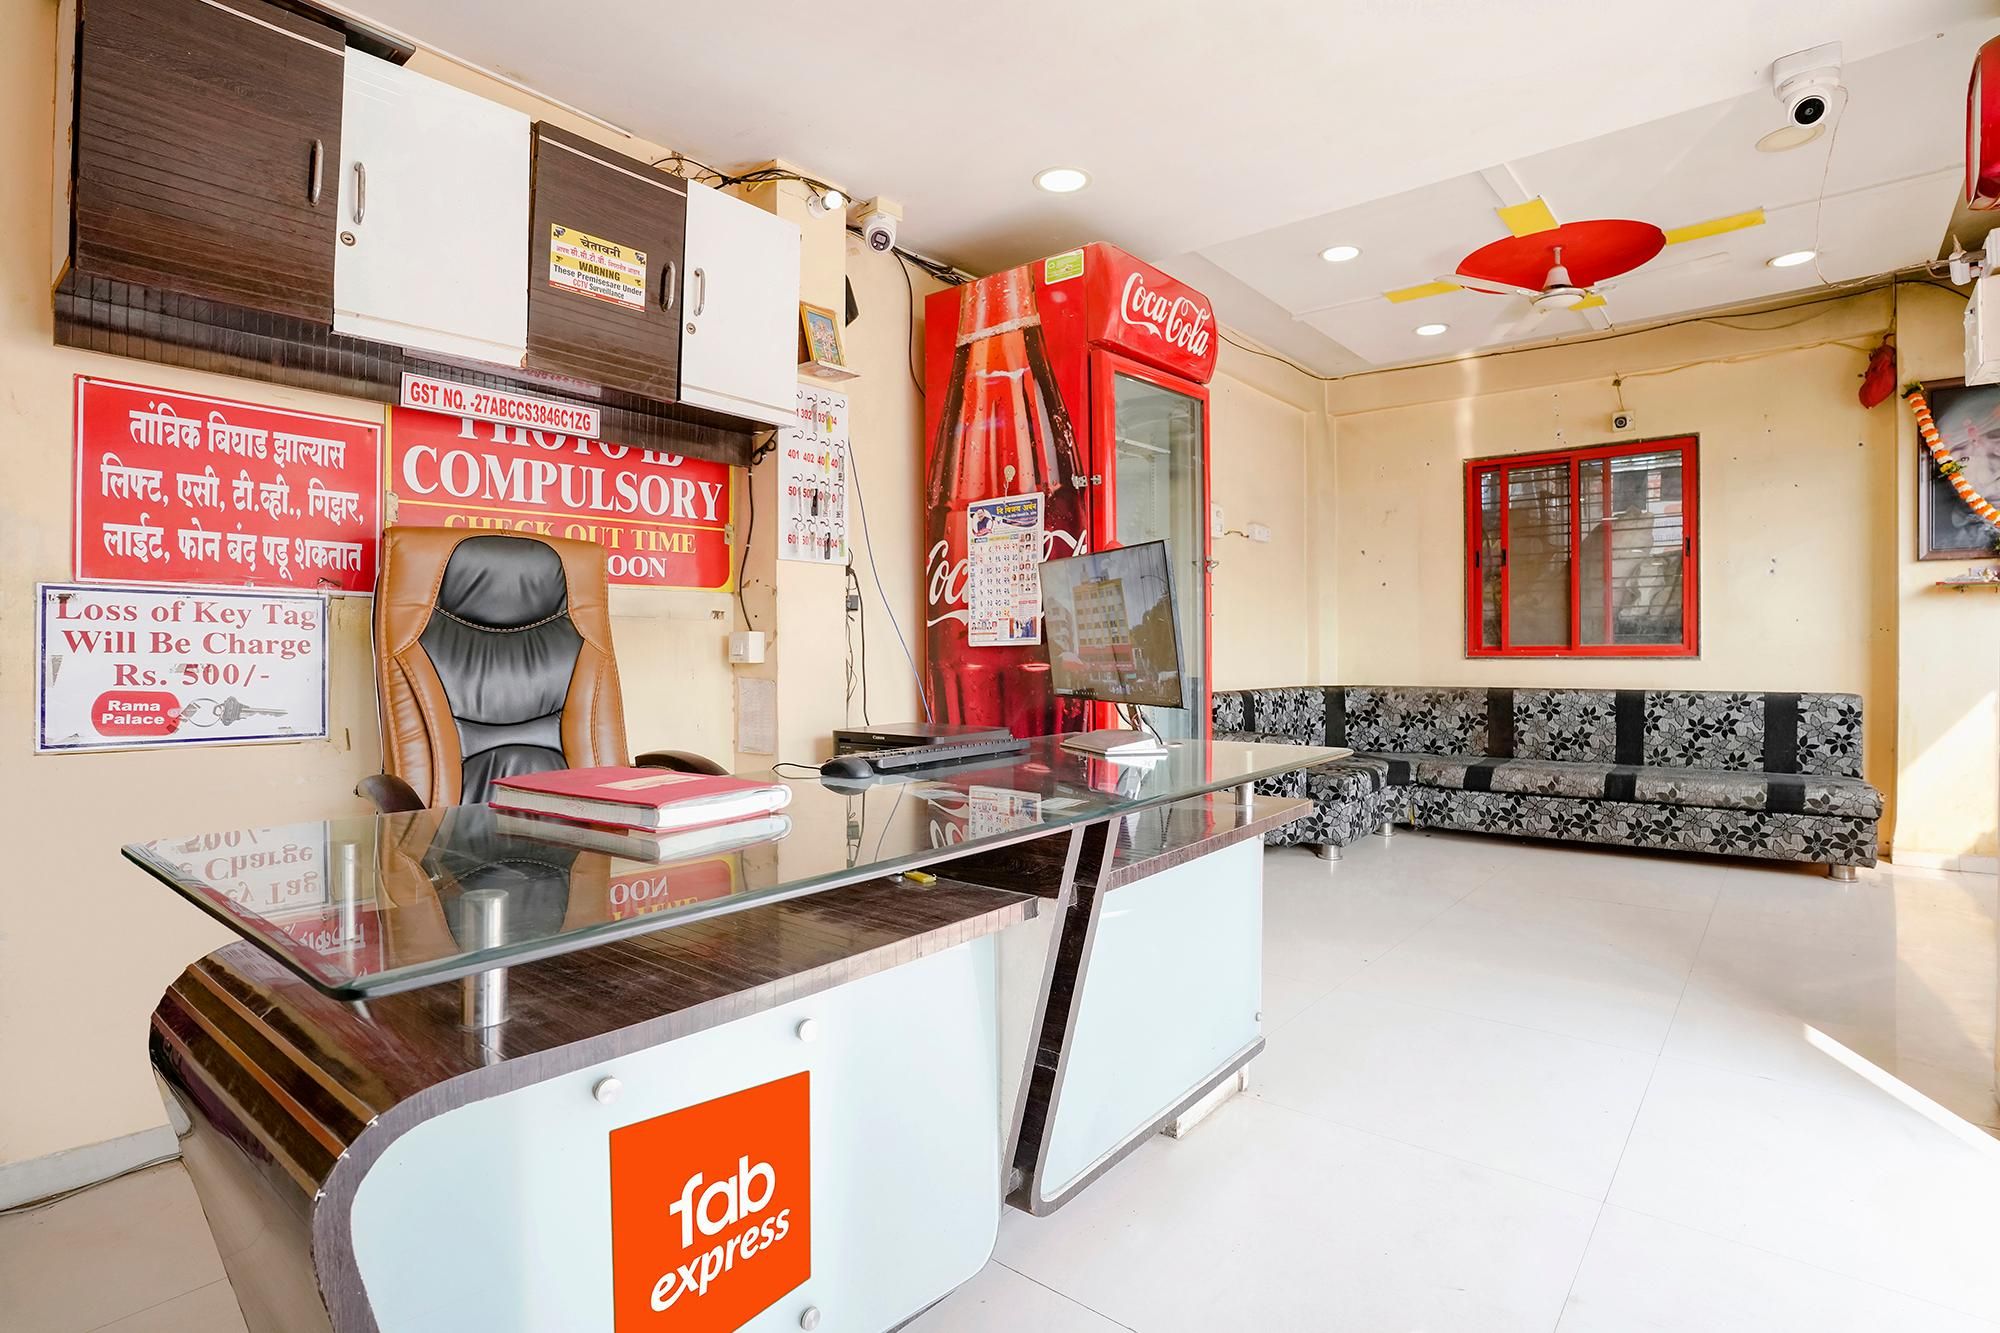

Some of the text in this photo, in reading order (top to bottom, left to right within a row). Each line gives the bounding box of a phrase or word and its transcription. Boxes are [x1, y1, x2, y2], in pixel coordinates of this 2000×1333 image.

[579, 236, 621, 258] चेतावनी
[553, 264, 576, 278] These
[622, 284, 643, 297] Under
[579, 261, 621, 281] WARNING
[572, 278, 589, 289] CCTV
[589, 282, 625, 299] Surveillance
[1120, 272, 1210, 356] Coca-Cola
[410, 381, 439, 406] GST
[129, 400, 202, 450] तांत्रिक
[272, 431, 346, 470] झाल्यास
[817, 455, 826, 466] 40
[100, 452, 169, 507] लिफ्ट,
[176, 465, 226, 512] एसी,
[308, 477, 364, 526] गिझर,
[402, 445, 724, 521] COMPULSORY
[102, 512, 362, 581] लाईट, फोन बंद पडू शकतात
[631, 529, 697, 554] TIME
[608, 555, 667, 578] OON
[55, 599, 316, 630] Loss of Key Tag
[62, 630, 312, 660] Will Be Charge
[113, 663, 270, 687] Rs. 500/-
[102, 713, 165, 725] Palace
[107, 700, 161, 713] Rama
[669, 1154, 776, 1250] fab
[650, 1208, 790, 1312] express
